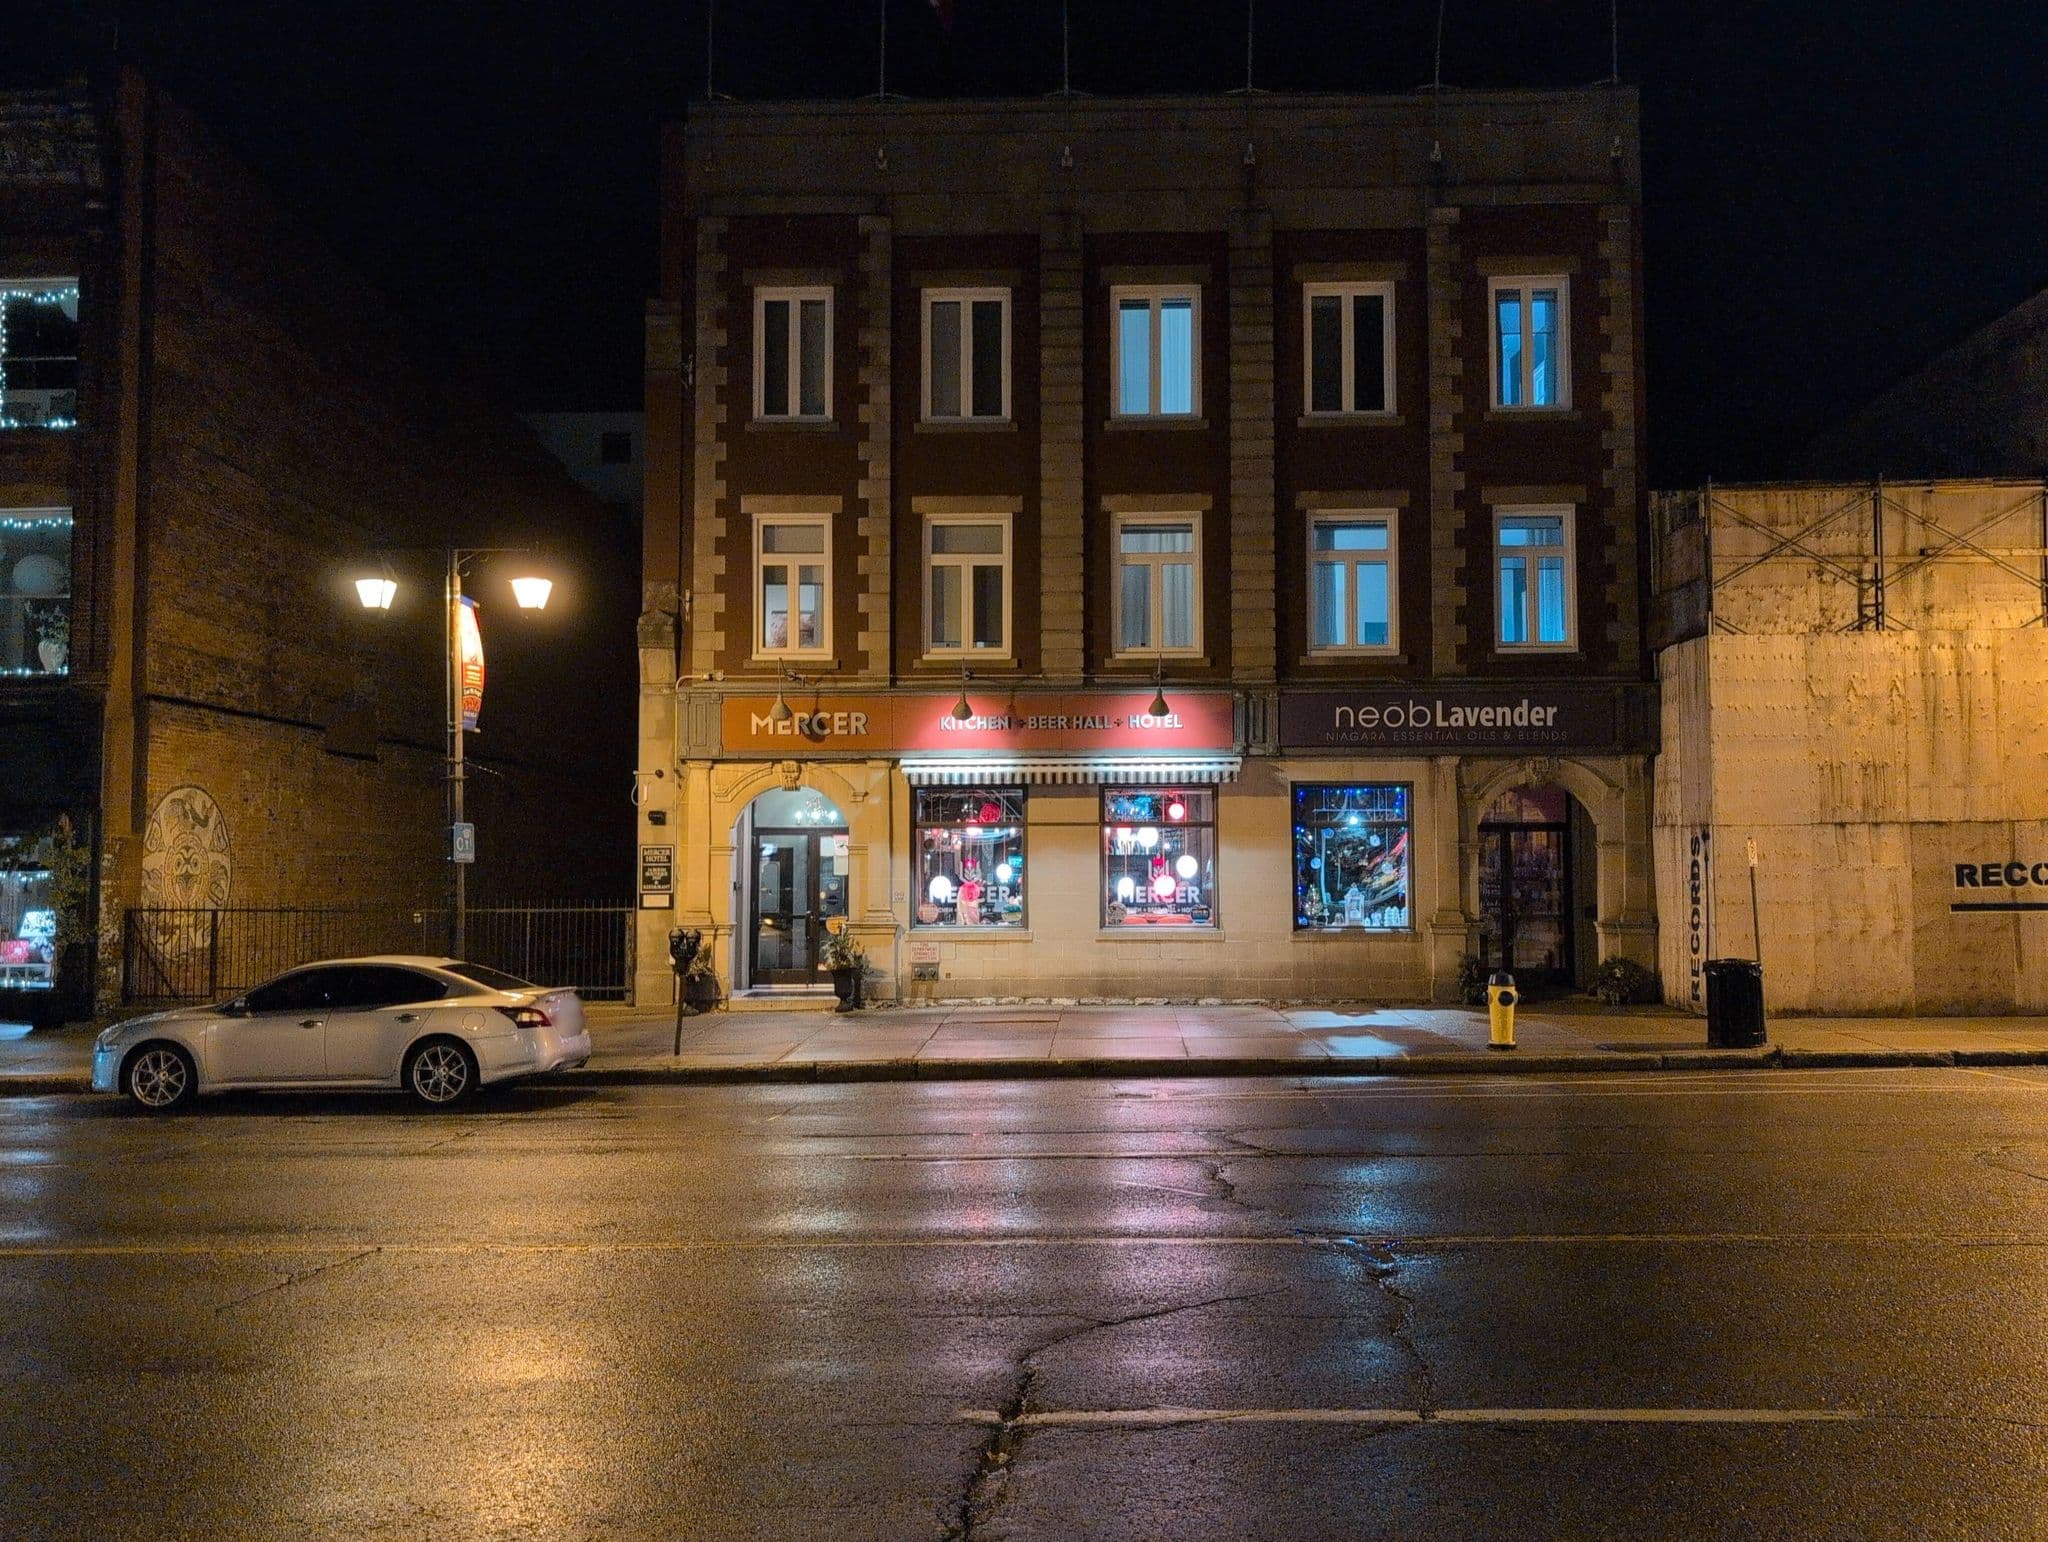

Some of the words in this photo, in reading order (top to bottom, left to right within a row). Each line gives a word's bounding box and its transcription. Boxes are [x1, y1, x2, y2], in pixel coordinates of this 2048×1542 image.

[751, 711, 868, 735] MERCER
[940, 715, 1010, 730] KITCHEN
[1028, 715, 1068, 729] BEER
[1073, 715, 1112, 729] HALL
[1128, 714, 1183, 729] HOTEL
[1326, 731, 1386, 742] NIAGARA
[1393, 731, 1458, 742] ESSENTIAL
[1467, 731, 1497, 742] OILS
[1518, 731, 1568, 742] BLENDS
[1690, 836, 1701, 1002] RECORDS
